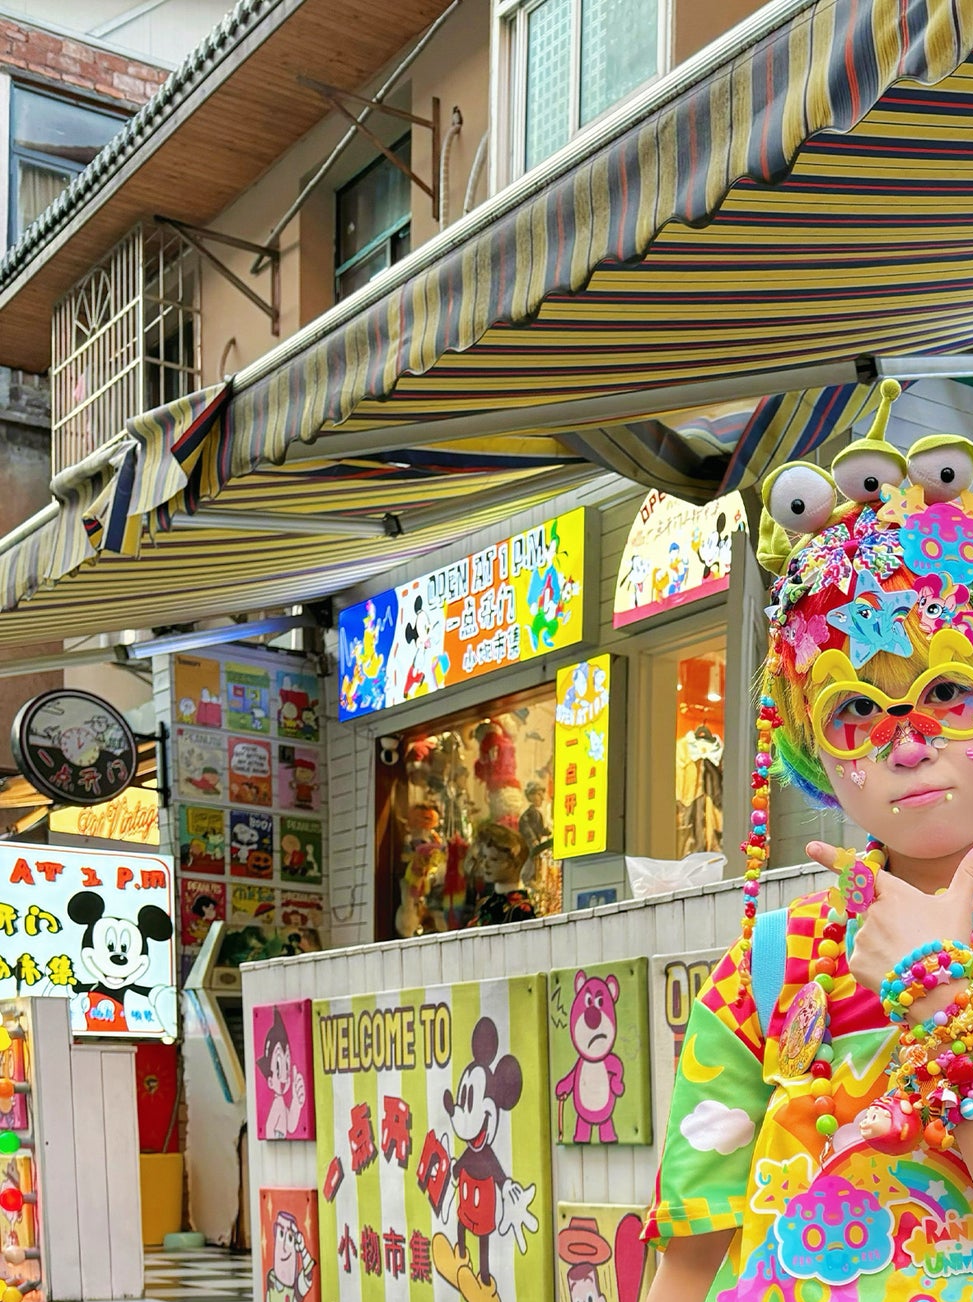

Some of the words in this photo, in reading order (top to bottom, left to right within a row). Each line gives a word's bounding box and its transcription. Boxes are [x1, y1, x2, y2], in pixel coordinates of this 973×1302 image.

[427, 558, 469, 611] OPEN
[471, 545, 498, 595] AT
[498, 541, 509, 580] 1
[446, 582, 517, 641] 一点开门
[38, 749, 128, 796] 一点开门
[9, 858, 65, 885] AT
[320, 1006, 416, 1075] WELCOME
[420, 1001, 452, 1069] TO
[338, 1222, 433, 1284] 小物市集
